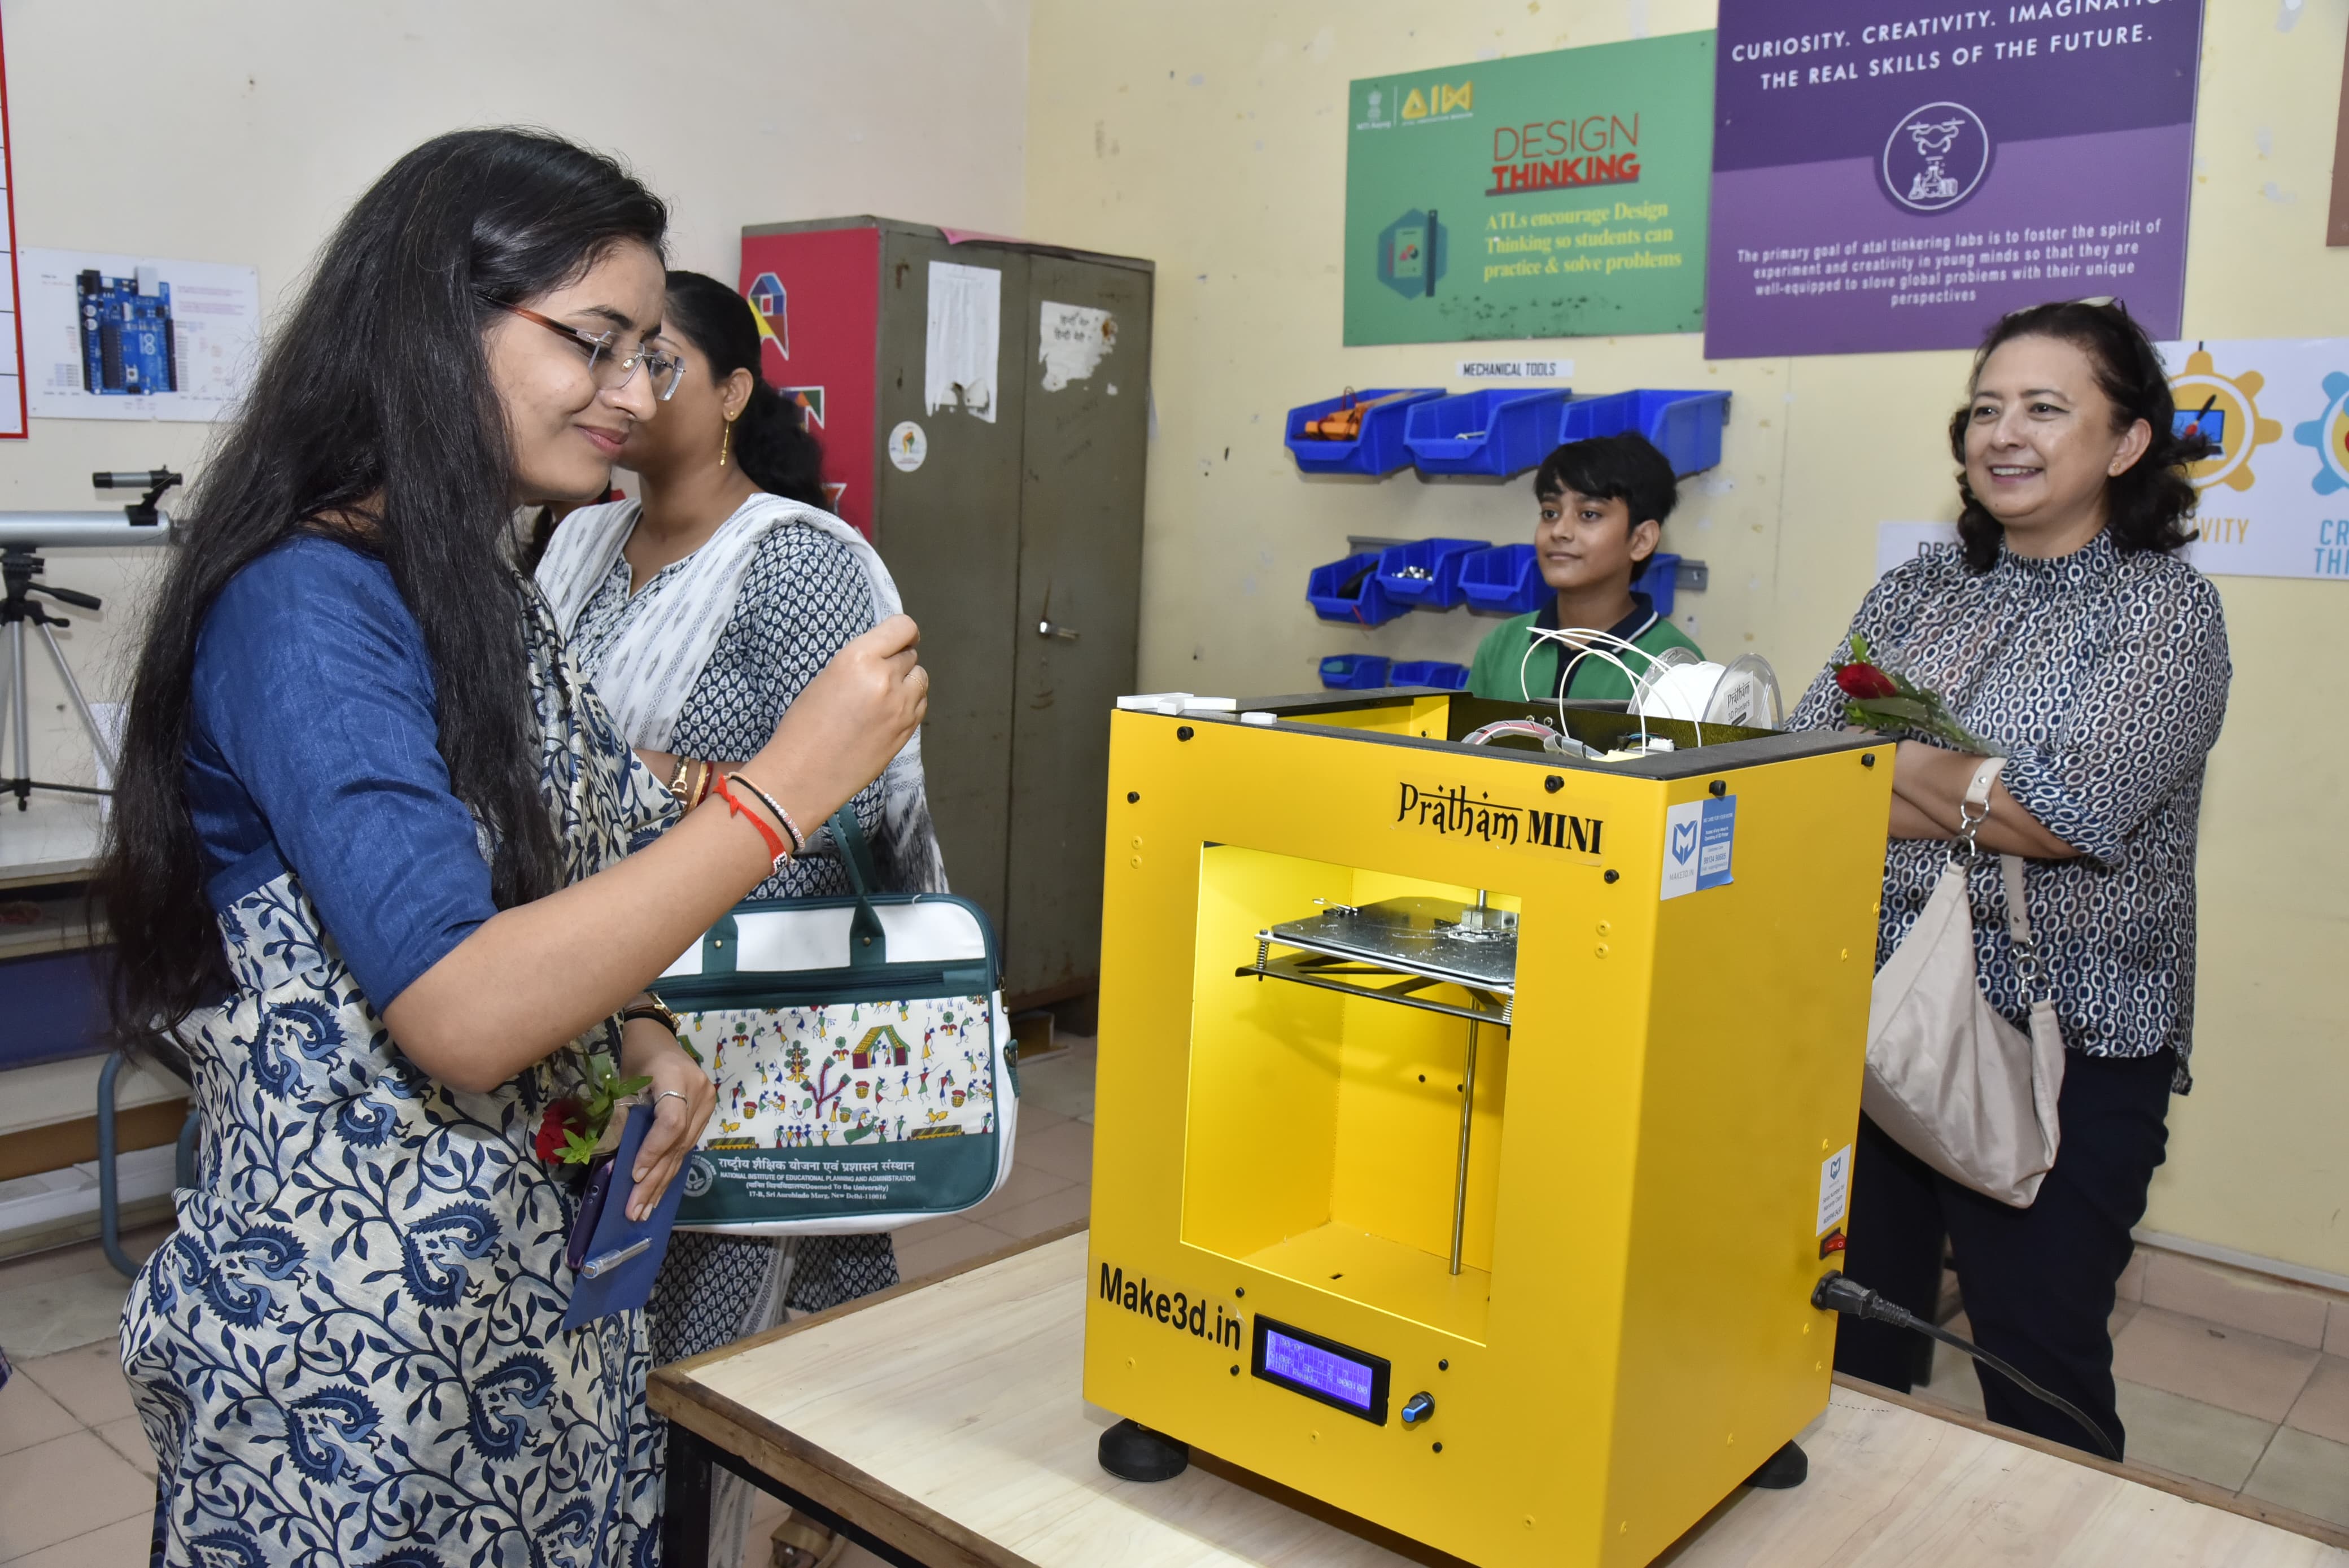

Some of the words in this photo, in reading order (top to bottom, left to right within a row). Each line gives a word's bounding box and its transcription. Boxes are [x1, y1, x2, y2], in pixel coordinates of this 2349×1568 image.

[1732, 30, 1850, 62] CURIOSITY.
[1862, 9, 1996, 44] CREATIVITY.
[2009, 0, 2173, 23] IMAGINA
[1761, 69, 1798, 90] THE
[1809, 62, 1858, 84] REAL
[1868, 51, 1941, 77] SKILLS
[1952, 46, 1983, 65] OF
[1994, 38, 2037, 60] THE
[2050, 24, 2152, 53] FUTURE.
[1494, 112, 1639, 161] DESIGN
[1492, 152, 1640, 192] THINKING
[1486, 211, 1527, 230] ATLs
[1531, 207, 1610, 228] encourage
[1614, 200, 1669, 222] Design
[1485, 233, 1552, 254] Thinking
[1556, 235, 1571, 248] so
[1575, 228, 1640, 247] students
[1644, 228, 1673, 243] can
[1737, 249, 1758, 263] The
[1762, 247, 1810, 264] primary
[1813, 242, 1840, 260] goal
[1844, 241, 1858, 256] of
[1891, 235, 1951, 252] tinkering
[1955, 232, 1984, 247] labs
[1988, 230, 2001, 245] is
[2005, 230, 2019, 244] to
[2024, 227, 2067, 242] foster
[2072, 225, 2094, 239] the
[2100, 220, 2141, 239] spirit
[2146, 218, 2162, 234] of
[1484, 259, 1542, 283] practice
[1545, 256, 1558, 274] &
[1564, 254, 1602, 272] solve
[1606, 250, 1682, 275] problems
[1753, 263, 1822, 281] experiment
[1824, 260, 1848, 275] and
[1852, 256, 1914, 272] creativity
[1919, 254, 1931, 268] in
[1935, 254, 1975, 270] young
[1979, 249, 2019, 264] minds
[2024, 247, 2040, 261] so
[2046, 244, 2073, 259] that
[2079, 242, 2110, 259] they
[2115, 242, 2139, 255] are
[1755, 278, 1841, 298] well-equipped
[1845, 277, 1858, 291] to
[1900, 272, 1941, 290] global
[1945, 268, 2006, 286] problems
[2011, 264, 2041, 281] with
[2046, 262, 2081, 278] their
[2086, 261, 2135, 277] unique
[1891, 289, 1976, 308] perspectives
[1463, 362, 1521, 377] MECHANICAL
[1526, 362, 1557, 377] TOOLS
[1734, 700, 1750, 717] Printers
[1397, 781, 1523, 846] Pratham
[1526, 809, 1604, 855] MINI
[718, 1156, 750, 1171] राष्ट्रीय
[752, 1156, 787, 1172] शैक्षिक
[788, 1158, 820, 1171] योजना
[822, 1159, 839, 1174] एवं
[841, 1162, 879, 1173] प्रशासन
[880, 1159, 915, 1172] संस्थान
[1100, 1262, 1242, 1351] Make3d.in
